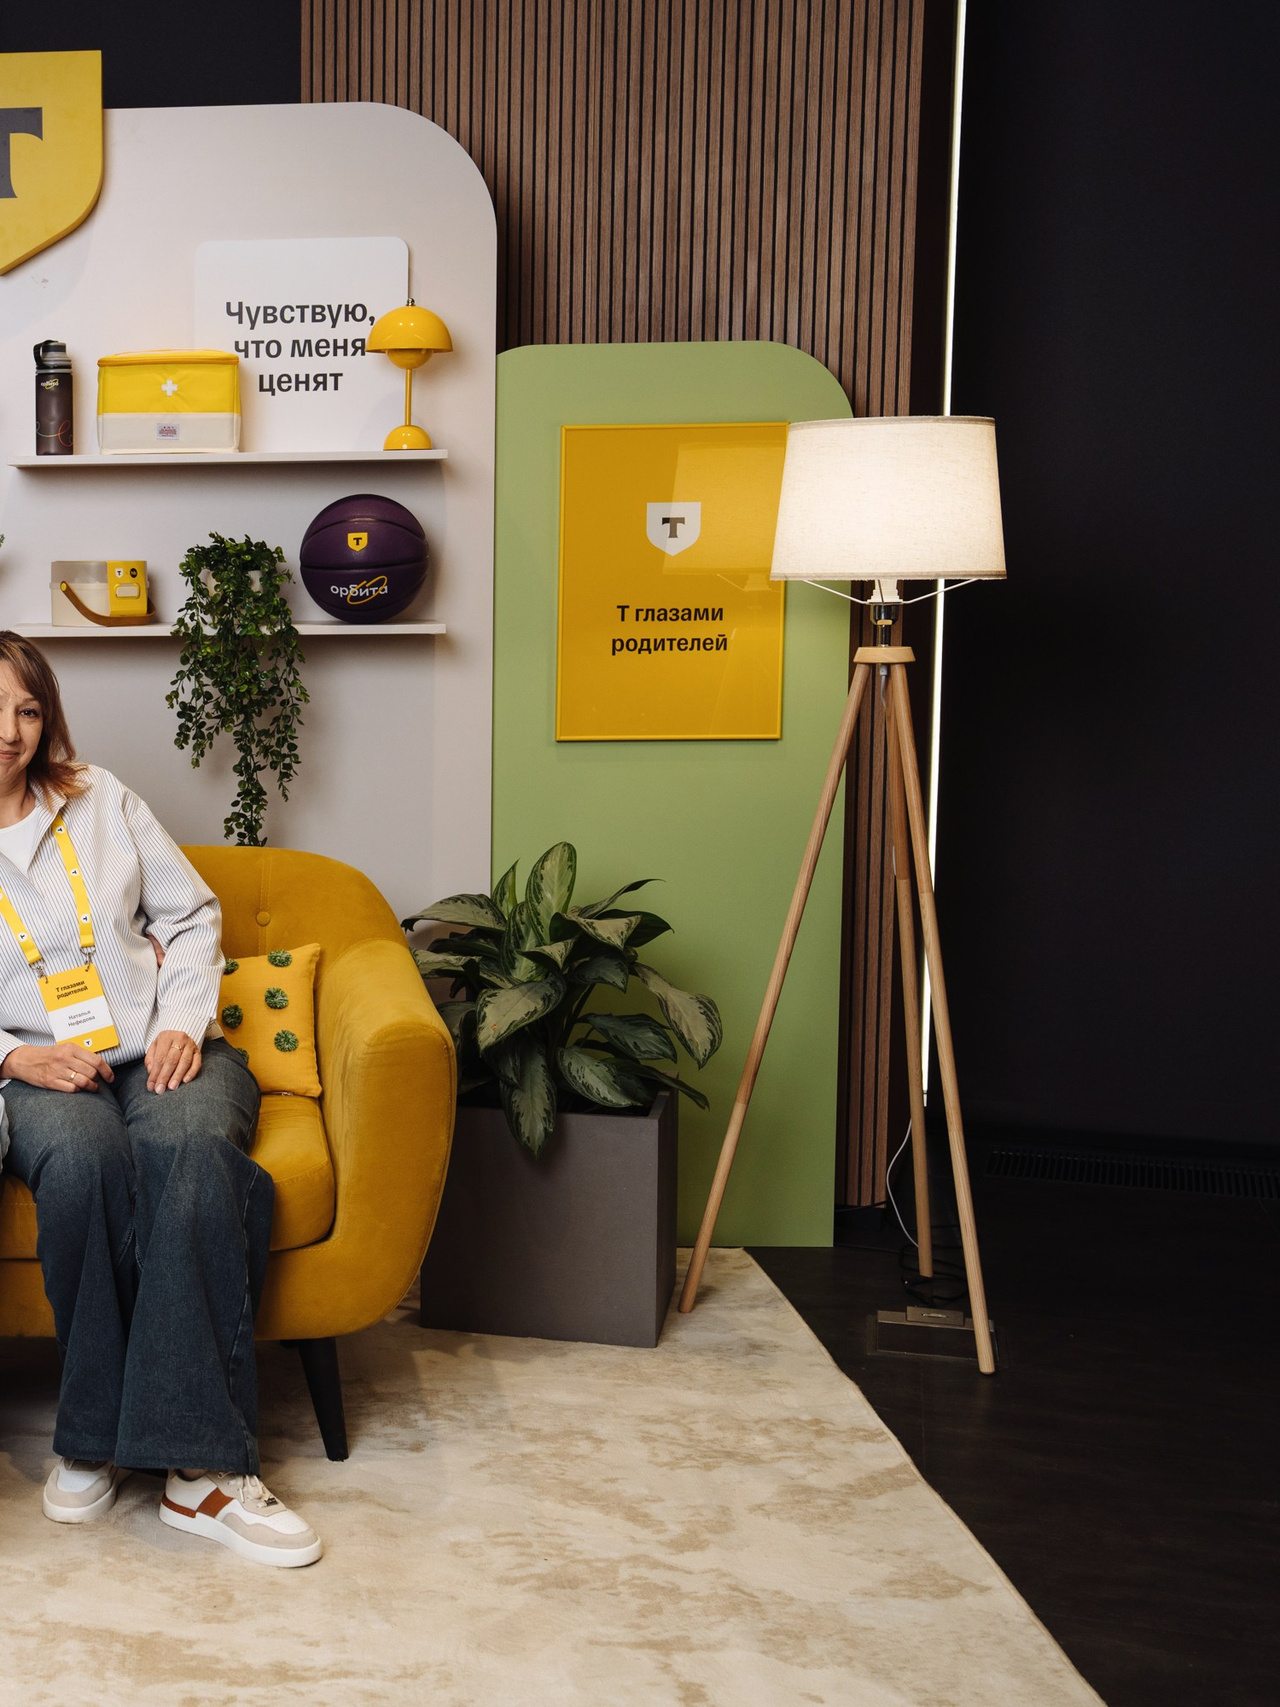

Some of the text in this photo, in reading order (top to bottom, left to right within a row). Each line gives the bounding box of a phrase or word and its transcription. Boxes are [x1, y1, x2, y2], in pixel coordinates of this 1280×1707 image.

[225, 301, 376, 331] Чувствую,
[234, 338, 367, 359] что меня
[258, 372, 344, 396] ценят
[661, 516, 686, 539] Т
[352, 537, 363, 546] Т
[329, 583, 389, 598] орбита
[616, 605, 724, 622] Т глазами
[611, 634, 728, 656] родителей
[56, 985, 89, 1000] родителей
[60, 980, 86, 992] глазами
